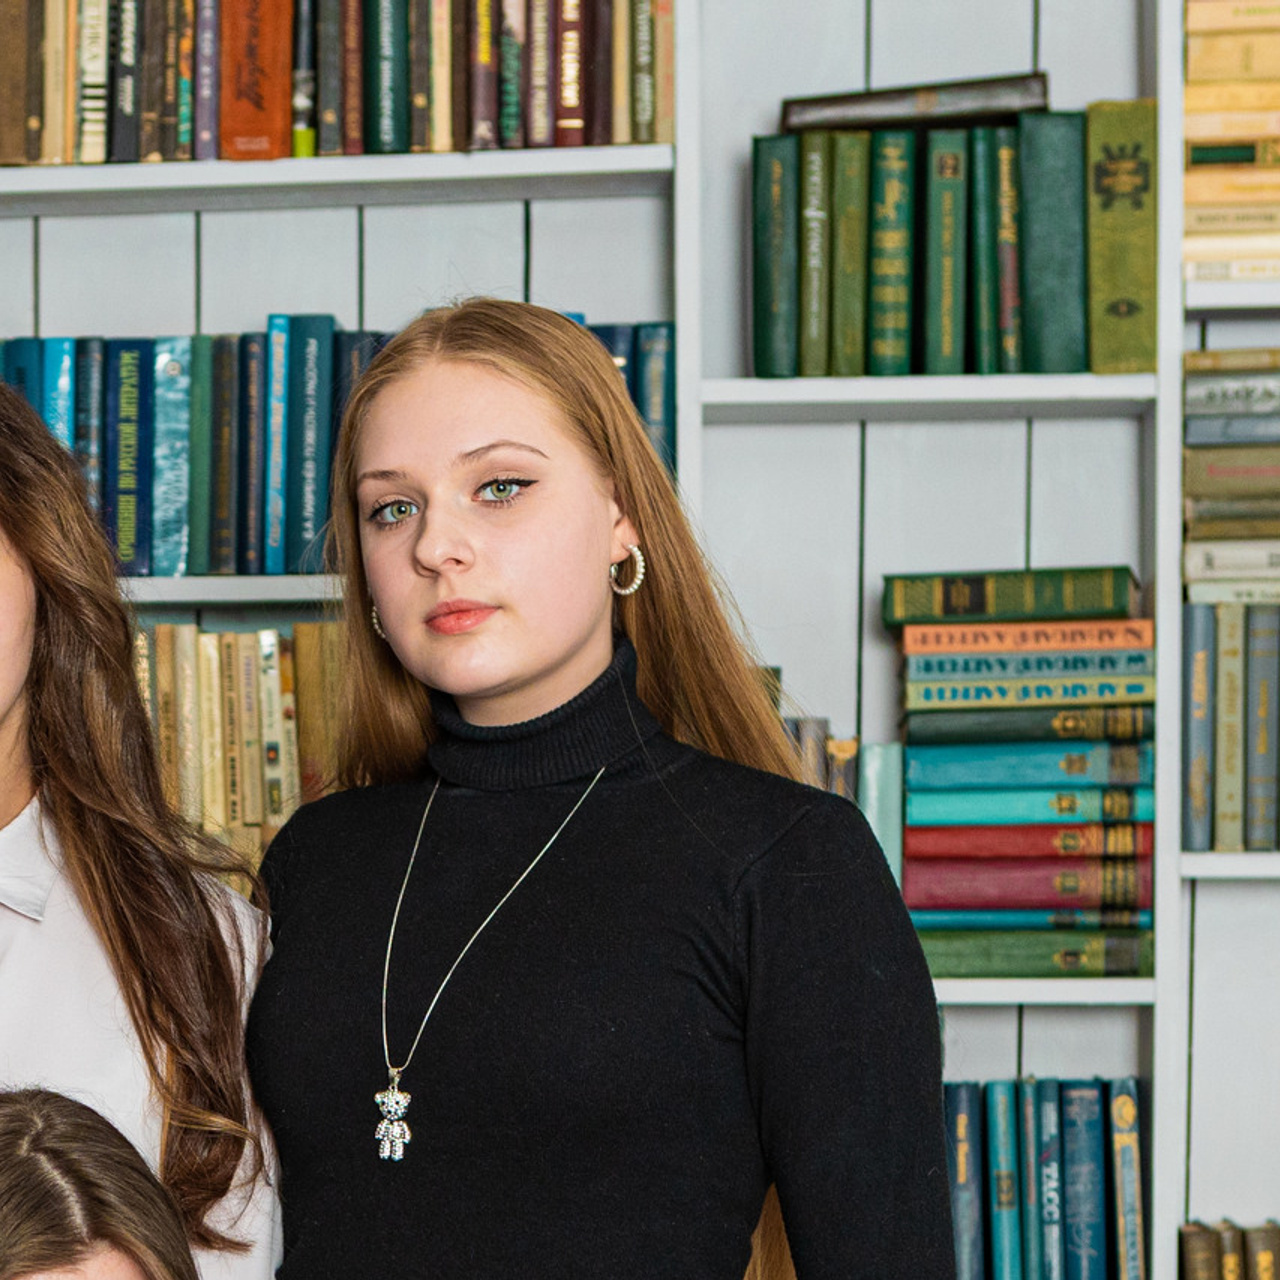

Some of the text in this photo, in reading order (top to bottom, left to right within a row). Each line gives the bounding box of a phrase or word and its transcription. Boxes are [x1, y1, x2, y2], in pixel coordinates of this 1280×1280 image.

[304, 337, 318, 396] РАССКАЗЫ
[117, 350, 139, 562] СОЧИНЕНИЯ ПО РУССКОЙ ЛИТЕРАТУРЕ
[304, 407, 317, 457] ПОВЕСТИ
[1042, 1161, 1060, 1222] ТАСС
